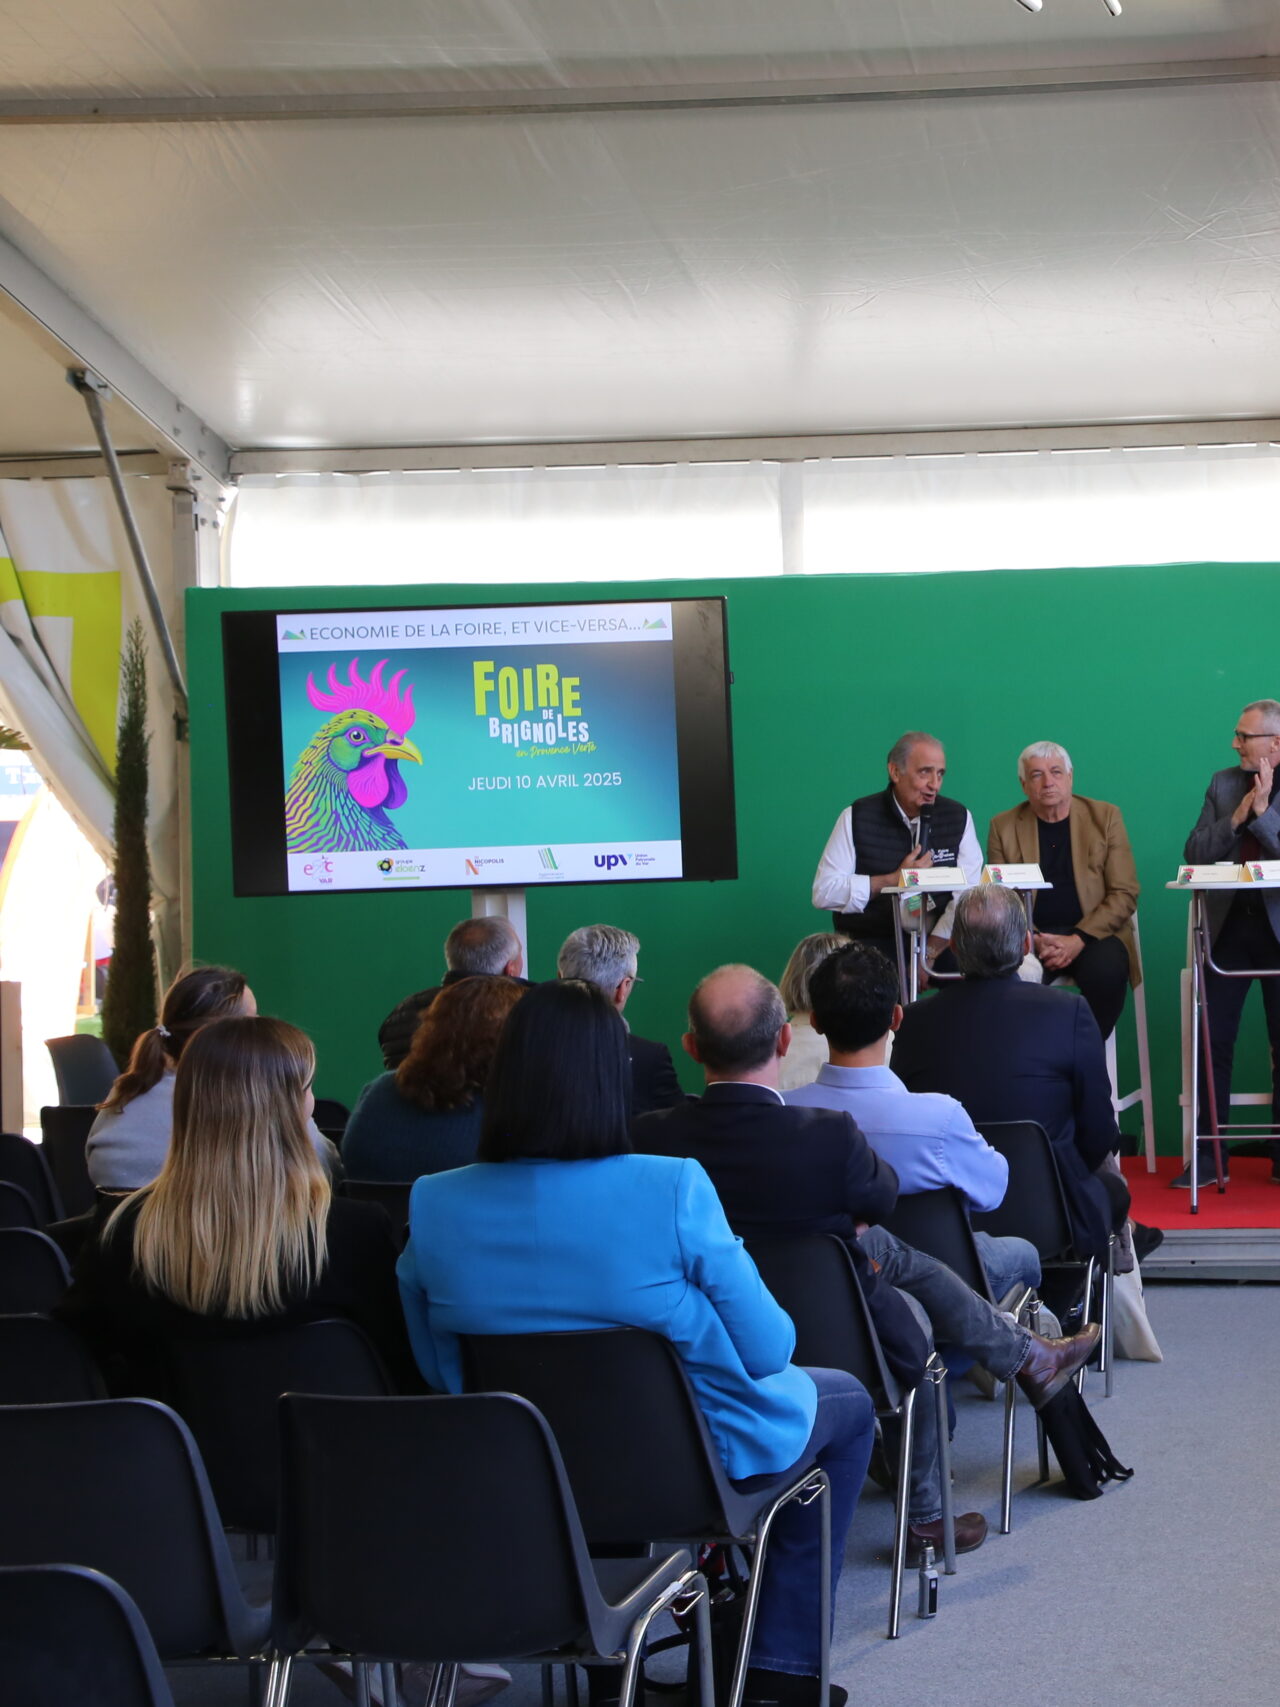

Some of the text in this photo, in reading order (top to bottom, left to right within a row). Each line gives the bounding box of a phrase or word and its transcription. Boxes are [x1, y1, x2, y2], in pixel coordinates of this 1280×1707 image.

[310, 618, 641, 641] ECONOMIE DE LA FOIRE, ET VICE-VERSA...
[473, 660, 582, 720] FOIRE
[542, 709, 554, 720] DE
[489, 714, 590, 748] BRIGNOLES
[530, 746, 570, 759] Provence
[572, 742, 597, 755] Verte
[468, 772, 622, 791] JEUDI 10 AVRIL 2025
[594, 853, 633, 871] upv
